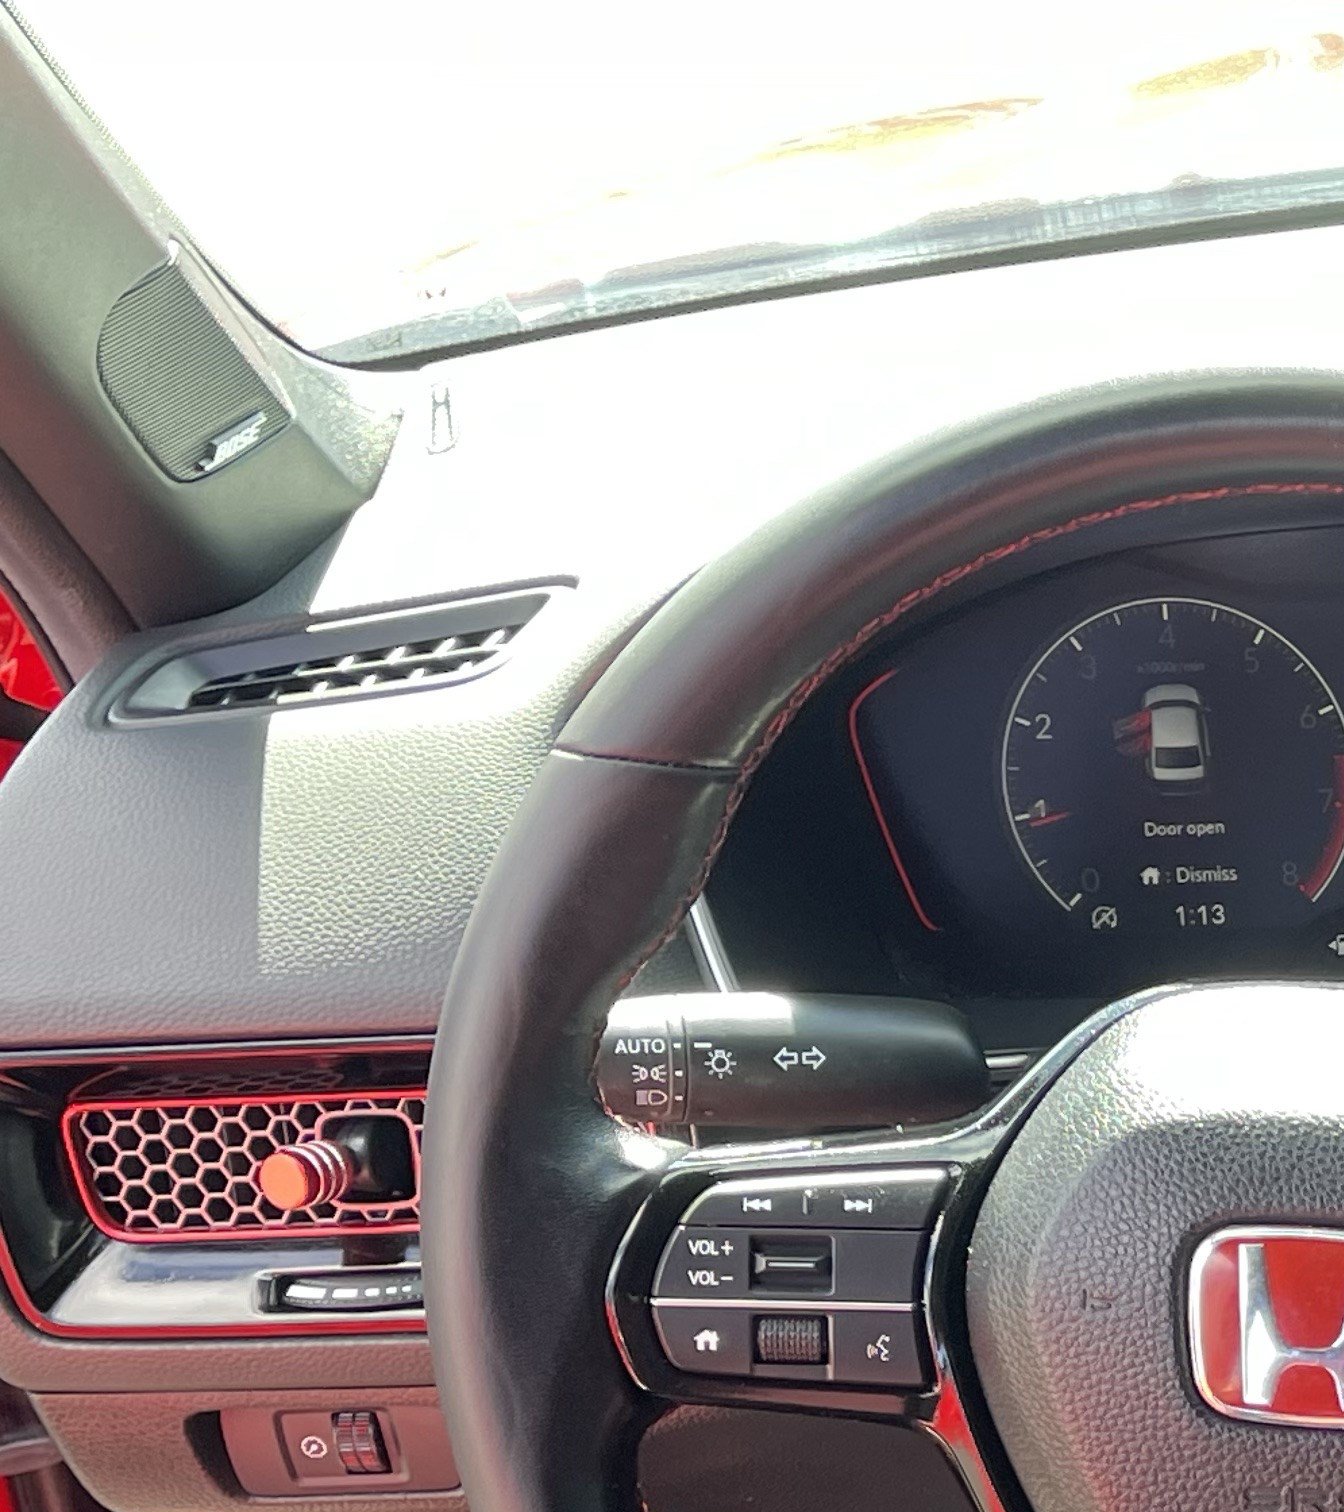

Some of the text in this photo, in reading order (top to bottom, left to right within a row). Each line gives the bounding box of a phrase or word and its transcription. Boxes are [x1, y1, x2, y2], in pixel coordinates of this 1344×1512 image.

[1157, 624, 1176, 648] 4
[1244, 650, 1260, 674] 5
[1035, 713, 1053, 740] 2
[1300, 705, 1317, 729] 6
[1033, 799, 1047, 818] 1
[1144, 821, 1226, 838] Door open
[1176, 865, 1238, 884] Dismiss
[1174, 904, 1226, 927] 1:13
[614, 1038, 666, 1054] AUTO
